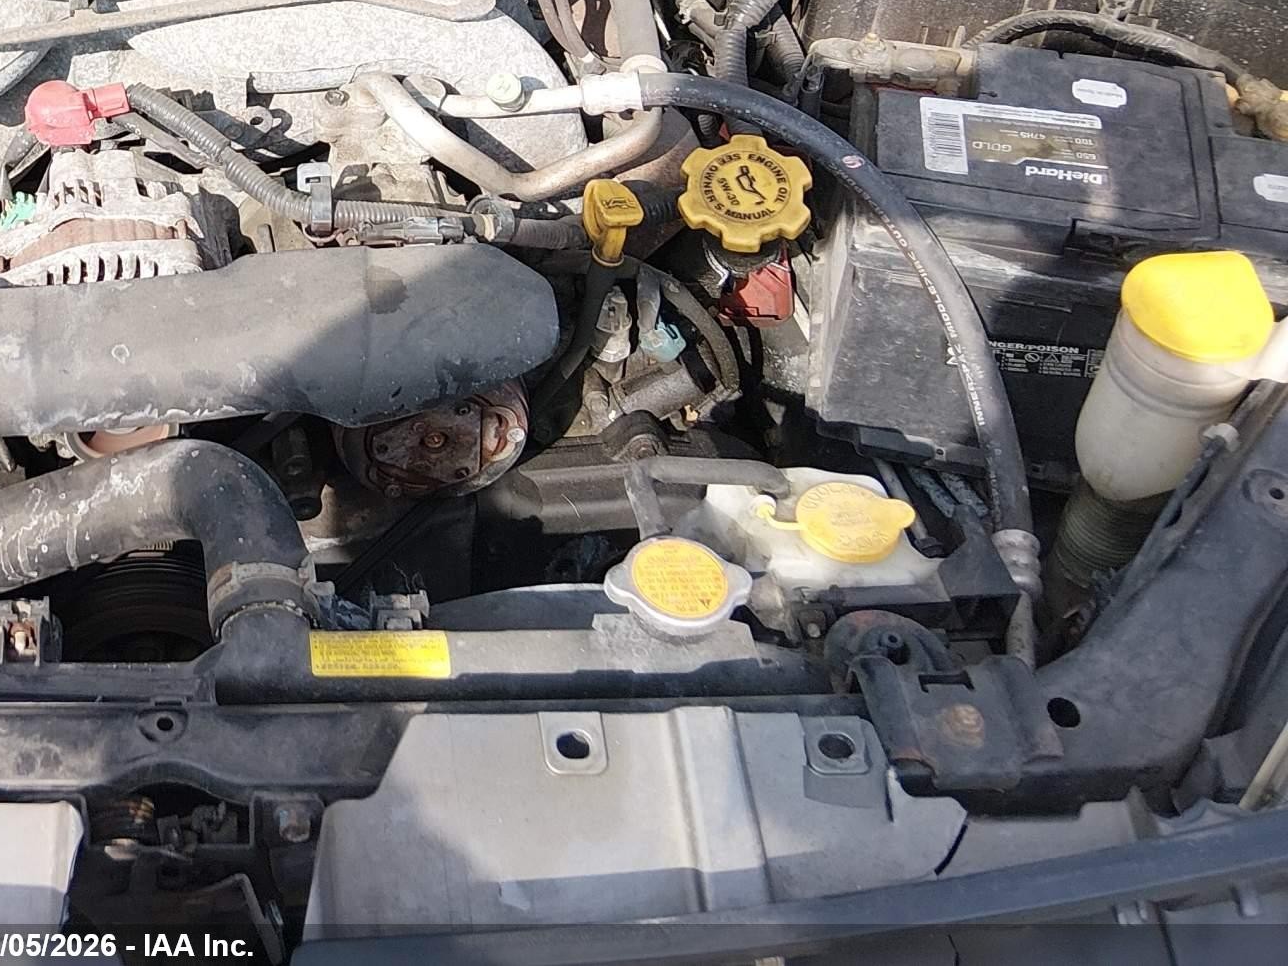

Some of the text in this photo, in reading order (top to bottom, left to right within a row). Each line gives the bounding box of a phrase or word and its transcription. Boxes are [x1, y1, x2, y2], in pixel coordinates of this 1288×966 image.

[972, 141, 1012, 153] GOLD
[718, 153, 742, 166] SEE
[747, 153, 786, 184] ENGINE
[774, 187, 788, 204] OIL
[1025, 165, 1103, 185] DieHard
[725, 208, 775, 220] MANUAL
[988, 340, 1079, 354] NGER/POISON
